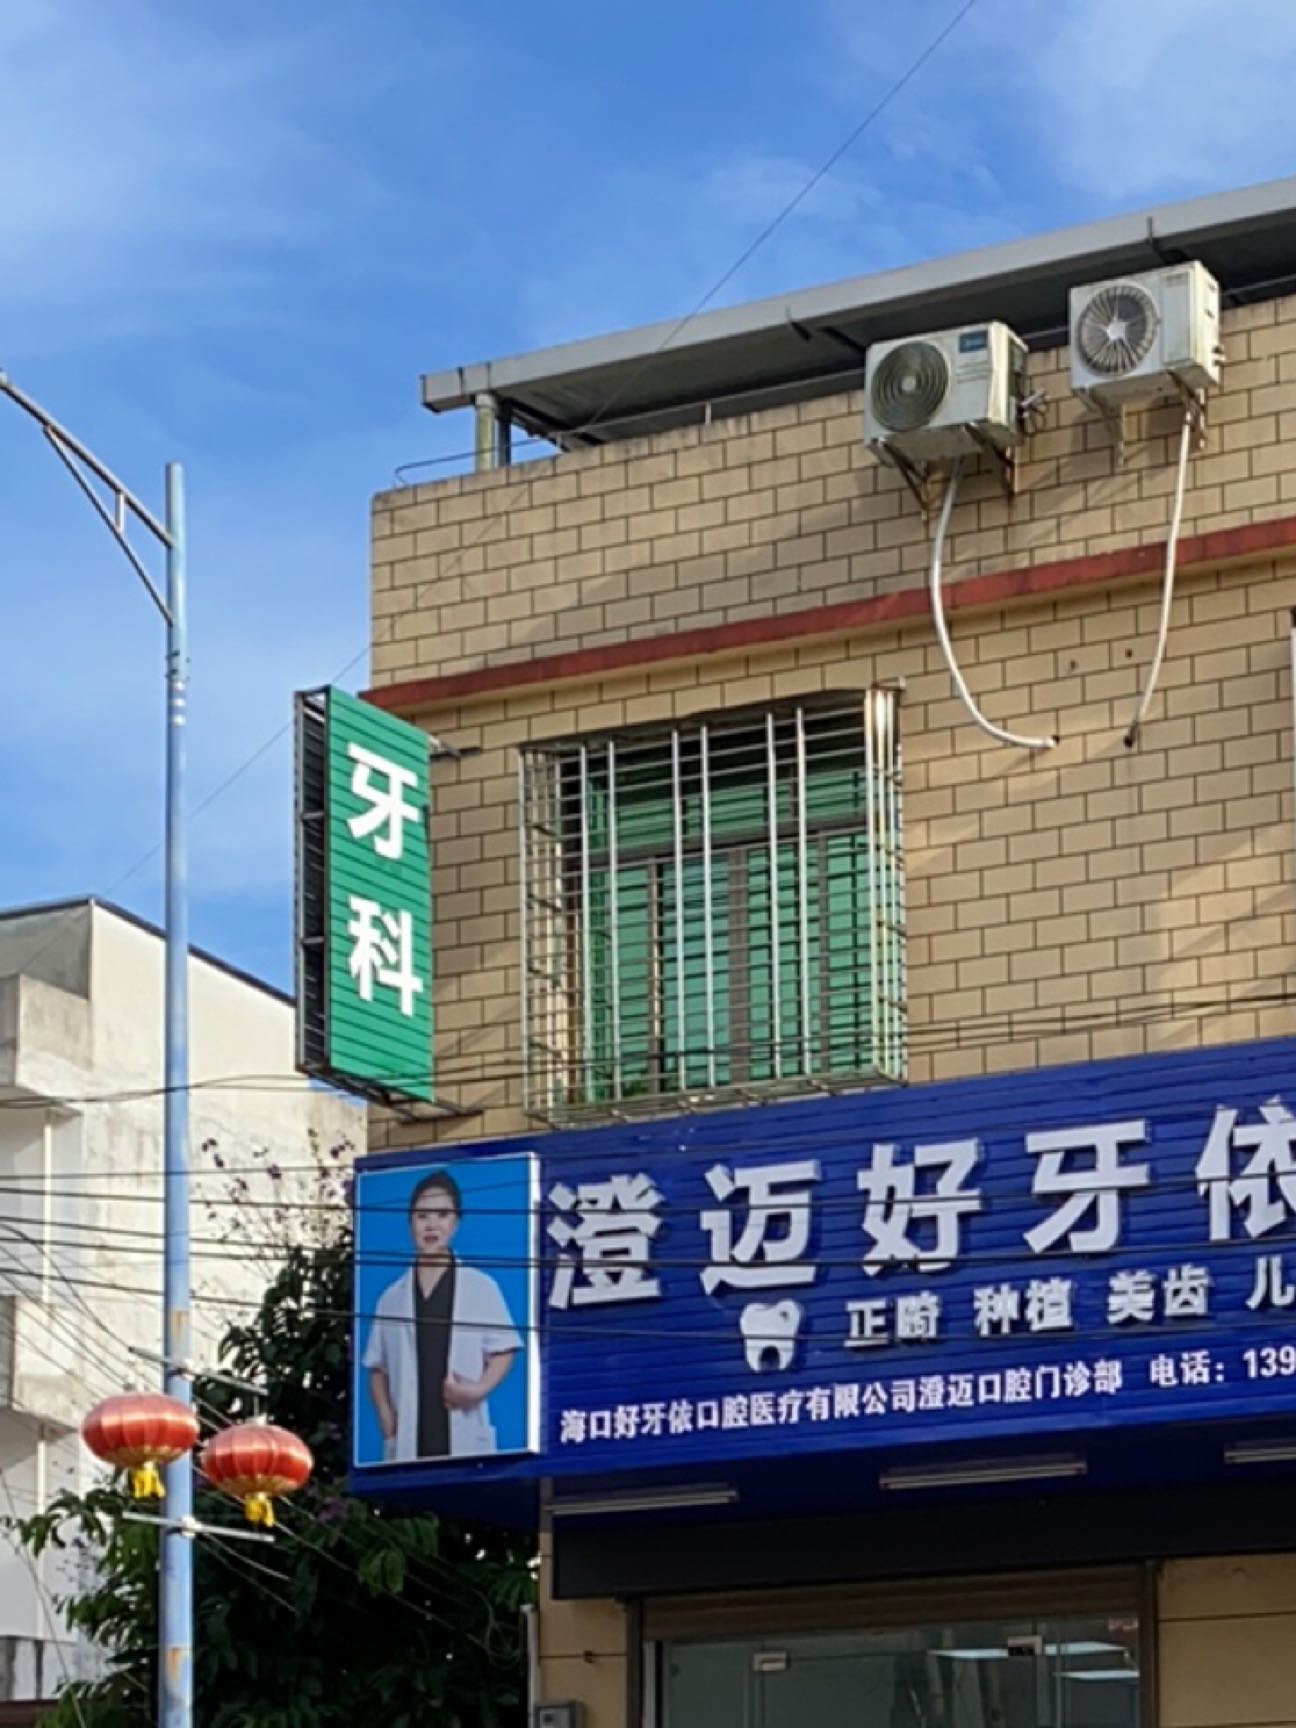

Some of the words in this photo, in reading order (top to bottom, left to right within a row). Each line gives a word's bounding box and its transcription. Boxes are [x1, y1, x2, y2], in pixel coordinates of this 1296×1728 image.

[347, 742, 423, 1017] 牙科
[844, 1290, 940, 1348] 正畸
[973, 1276, 1073, 1337] 种植
[1107, 1264, 1211, 1325] 美齿
[560, 1358, 1123, 1443] 海口好牙依口腔医疗有限公司澄迈口腔门诊部
